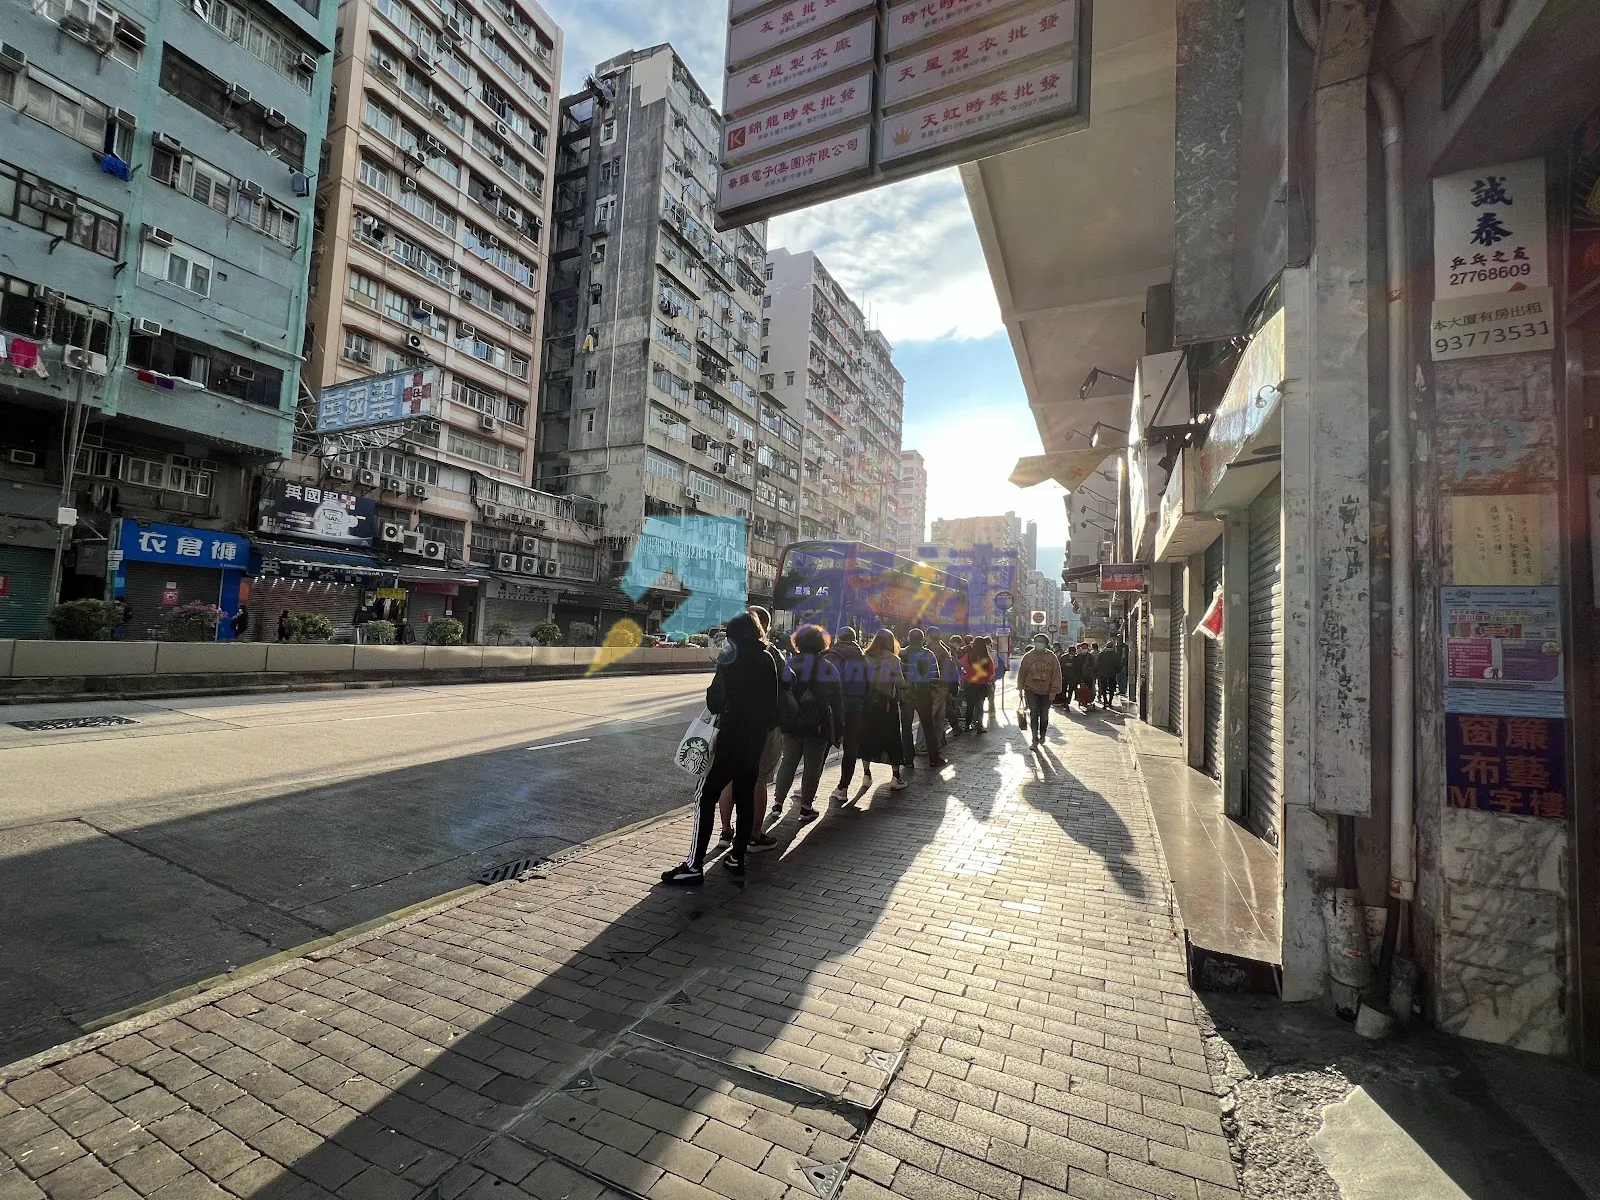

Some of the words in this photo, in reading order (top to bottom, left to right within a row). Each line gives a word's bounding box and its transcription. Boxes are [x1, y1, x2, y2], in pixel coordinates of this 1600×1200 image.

[746, 37, 851, 87] 志成製衣廠
[898, 13, 1060, 82] 天星製衣批發
[747, 87, 856, 135] 錦龍時裝批發
[920, 73, 1060, 129] 天虹時裝批發
[1469, 175, 1514, 247] 誠泰
[1450, 247, 1531, 270] 乒乓之友
[1450, 263, 1531, 286] 27768609
[1433, 302, 1543, 331] 本大廈有房出租
[1435, 320, 1549, 353] 93773531
[138, 532, 237, 560] 衣倉褲
[816, 586, 829, 596] 45
[1458, 715, 1550, 750] 窗簾
[1459, 752, 1550, 789] 布藝
